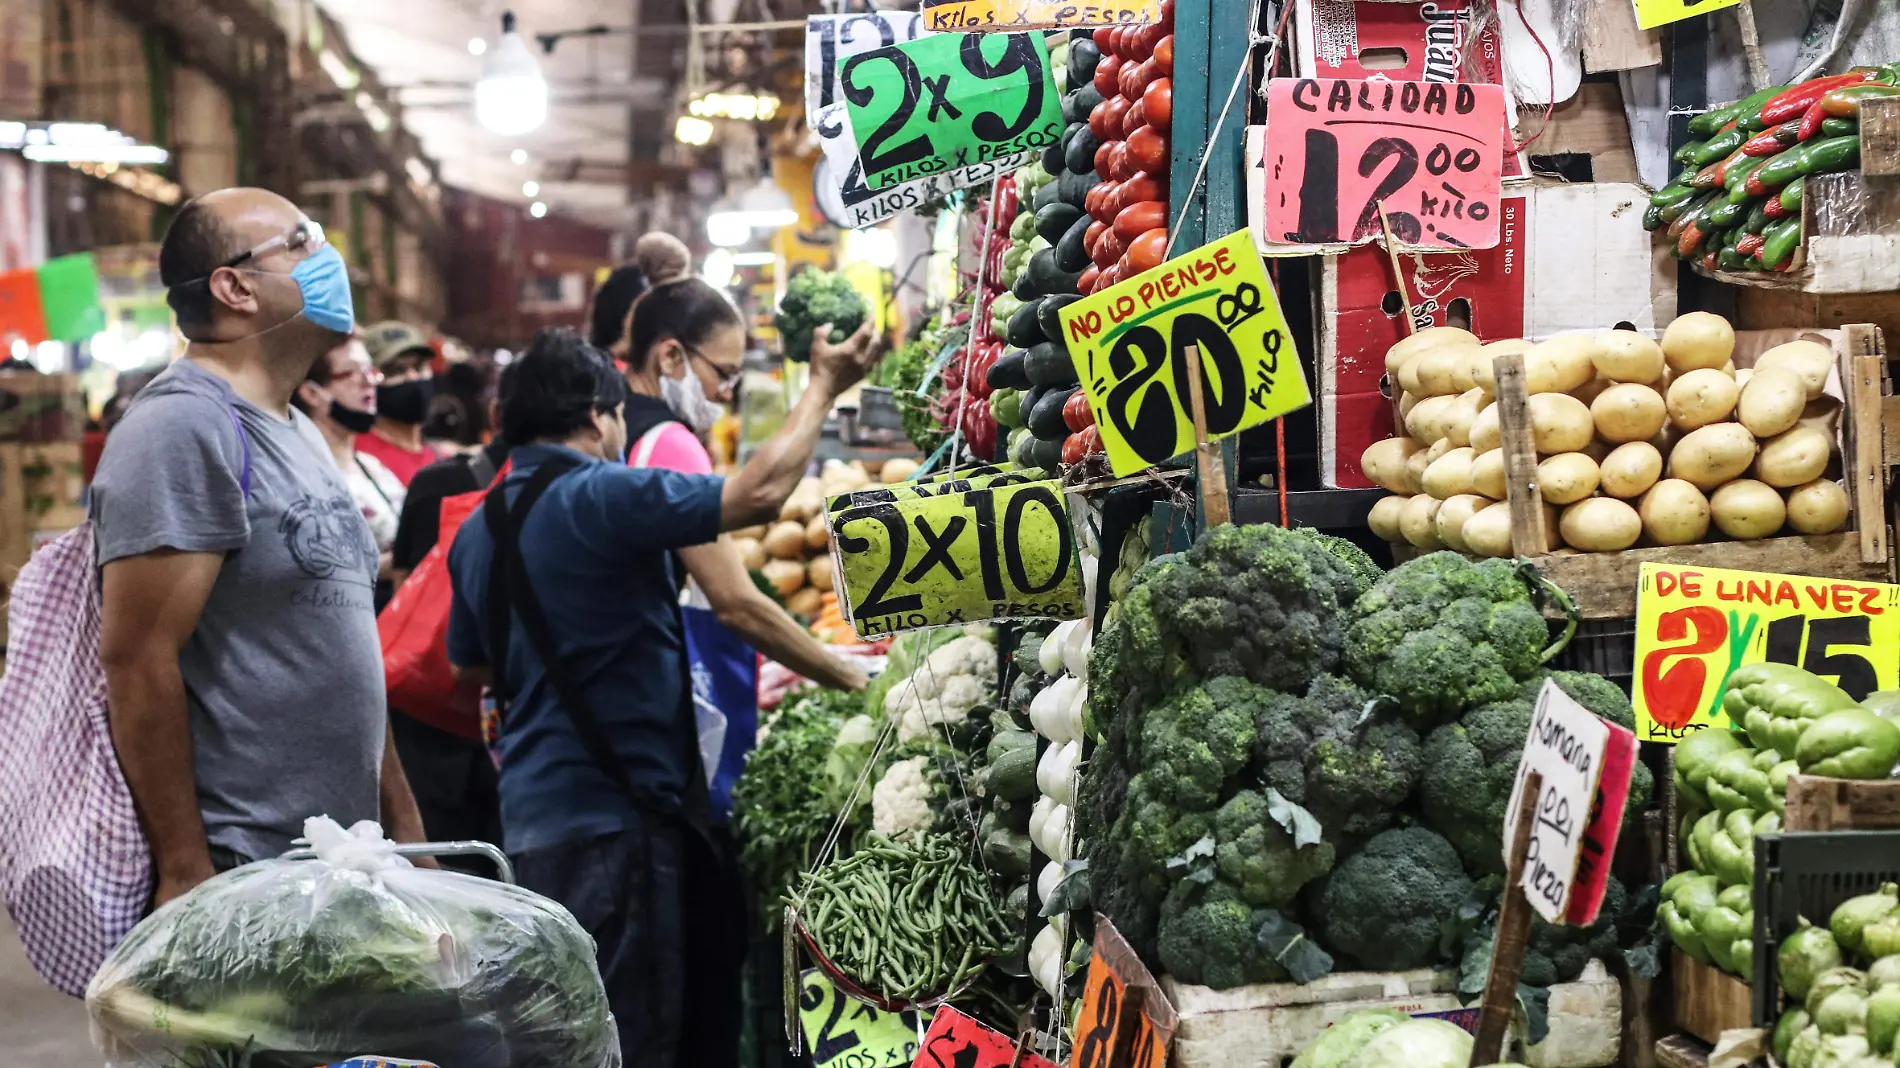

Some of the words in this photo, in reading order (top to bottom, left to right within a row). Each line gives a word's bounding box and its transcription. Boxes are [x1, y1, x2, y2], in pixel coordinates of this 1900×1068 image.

[1481, 29, 1495, 59] AJOS
[1292, 78, 1476, 115] CALIDAD
[880, 155, 947, 187] KILOS
[978, 122, 1061, 162] PESOS
[856, 186, 918, 224] KILOS
[1505, 207, 1514, 220] 30
[1505, 222, 1514, 246] Lbs.
[1504, 249, 1514, 275] Neto
[1069, 310, 1102, 343] NO
[1107, 295, 1135, 324] LO
[1137, 247, 1236, 310] PIENSE
[1249, 328, 1283, 410] KILO
[1106, 312, 1247, 465] 20
[1716, 578, 1801, 611] UNA
[862, 612, 928, 638] KILO
[992, 601, 1076, 619] PESOS
